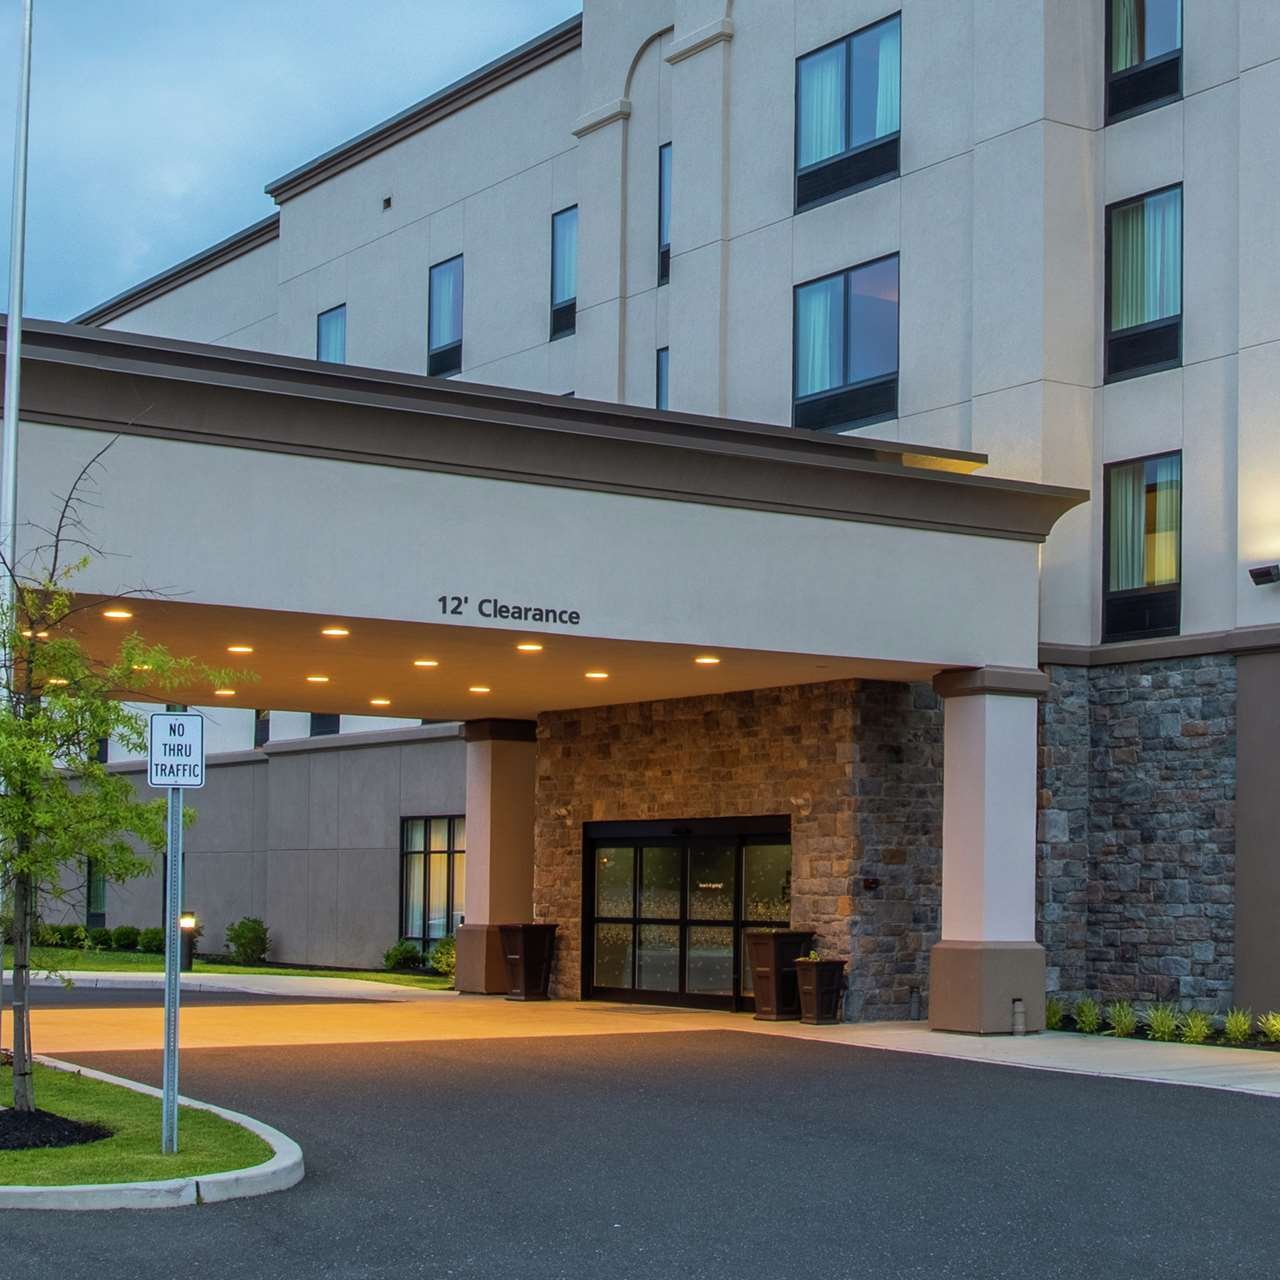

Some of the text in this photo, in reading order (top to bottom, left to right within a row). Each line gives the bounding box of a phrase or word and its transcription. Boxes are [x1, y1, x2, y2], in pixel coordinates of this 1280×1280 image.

[437, 595, 581, 625] 12' Clearance
[169, 722, 185, 737] NO
[162, 743, 192, 758] THRU
[154, 763, 200, 778] TRAFFIC
